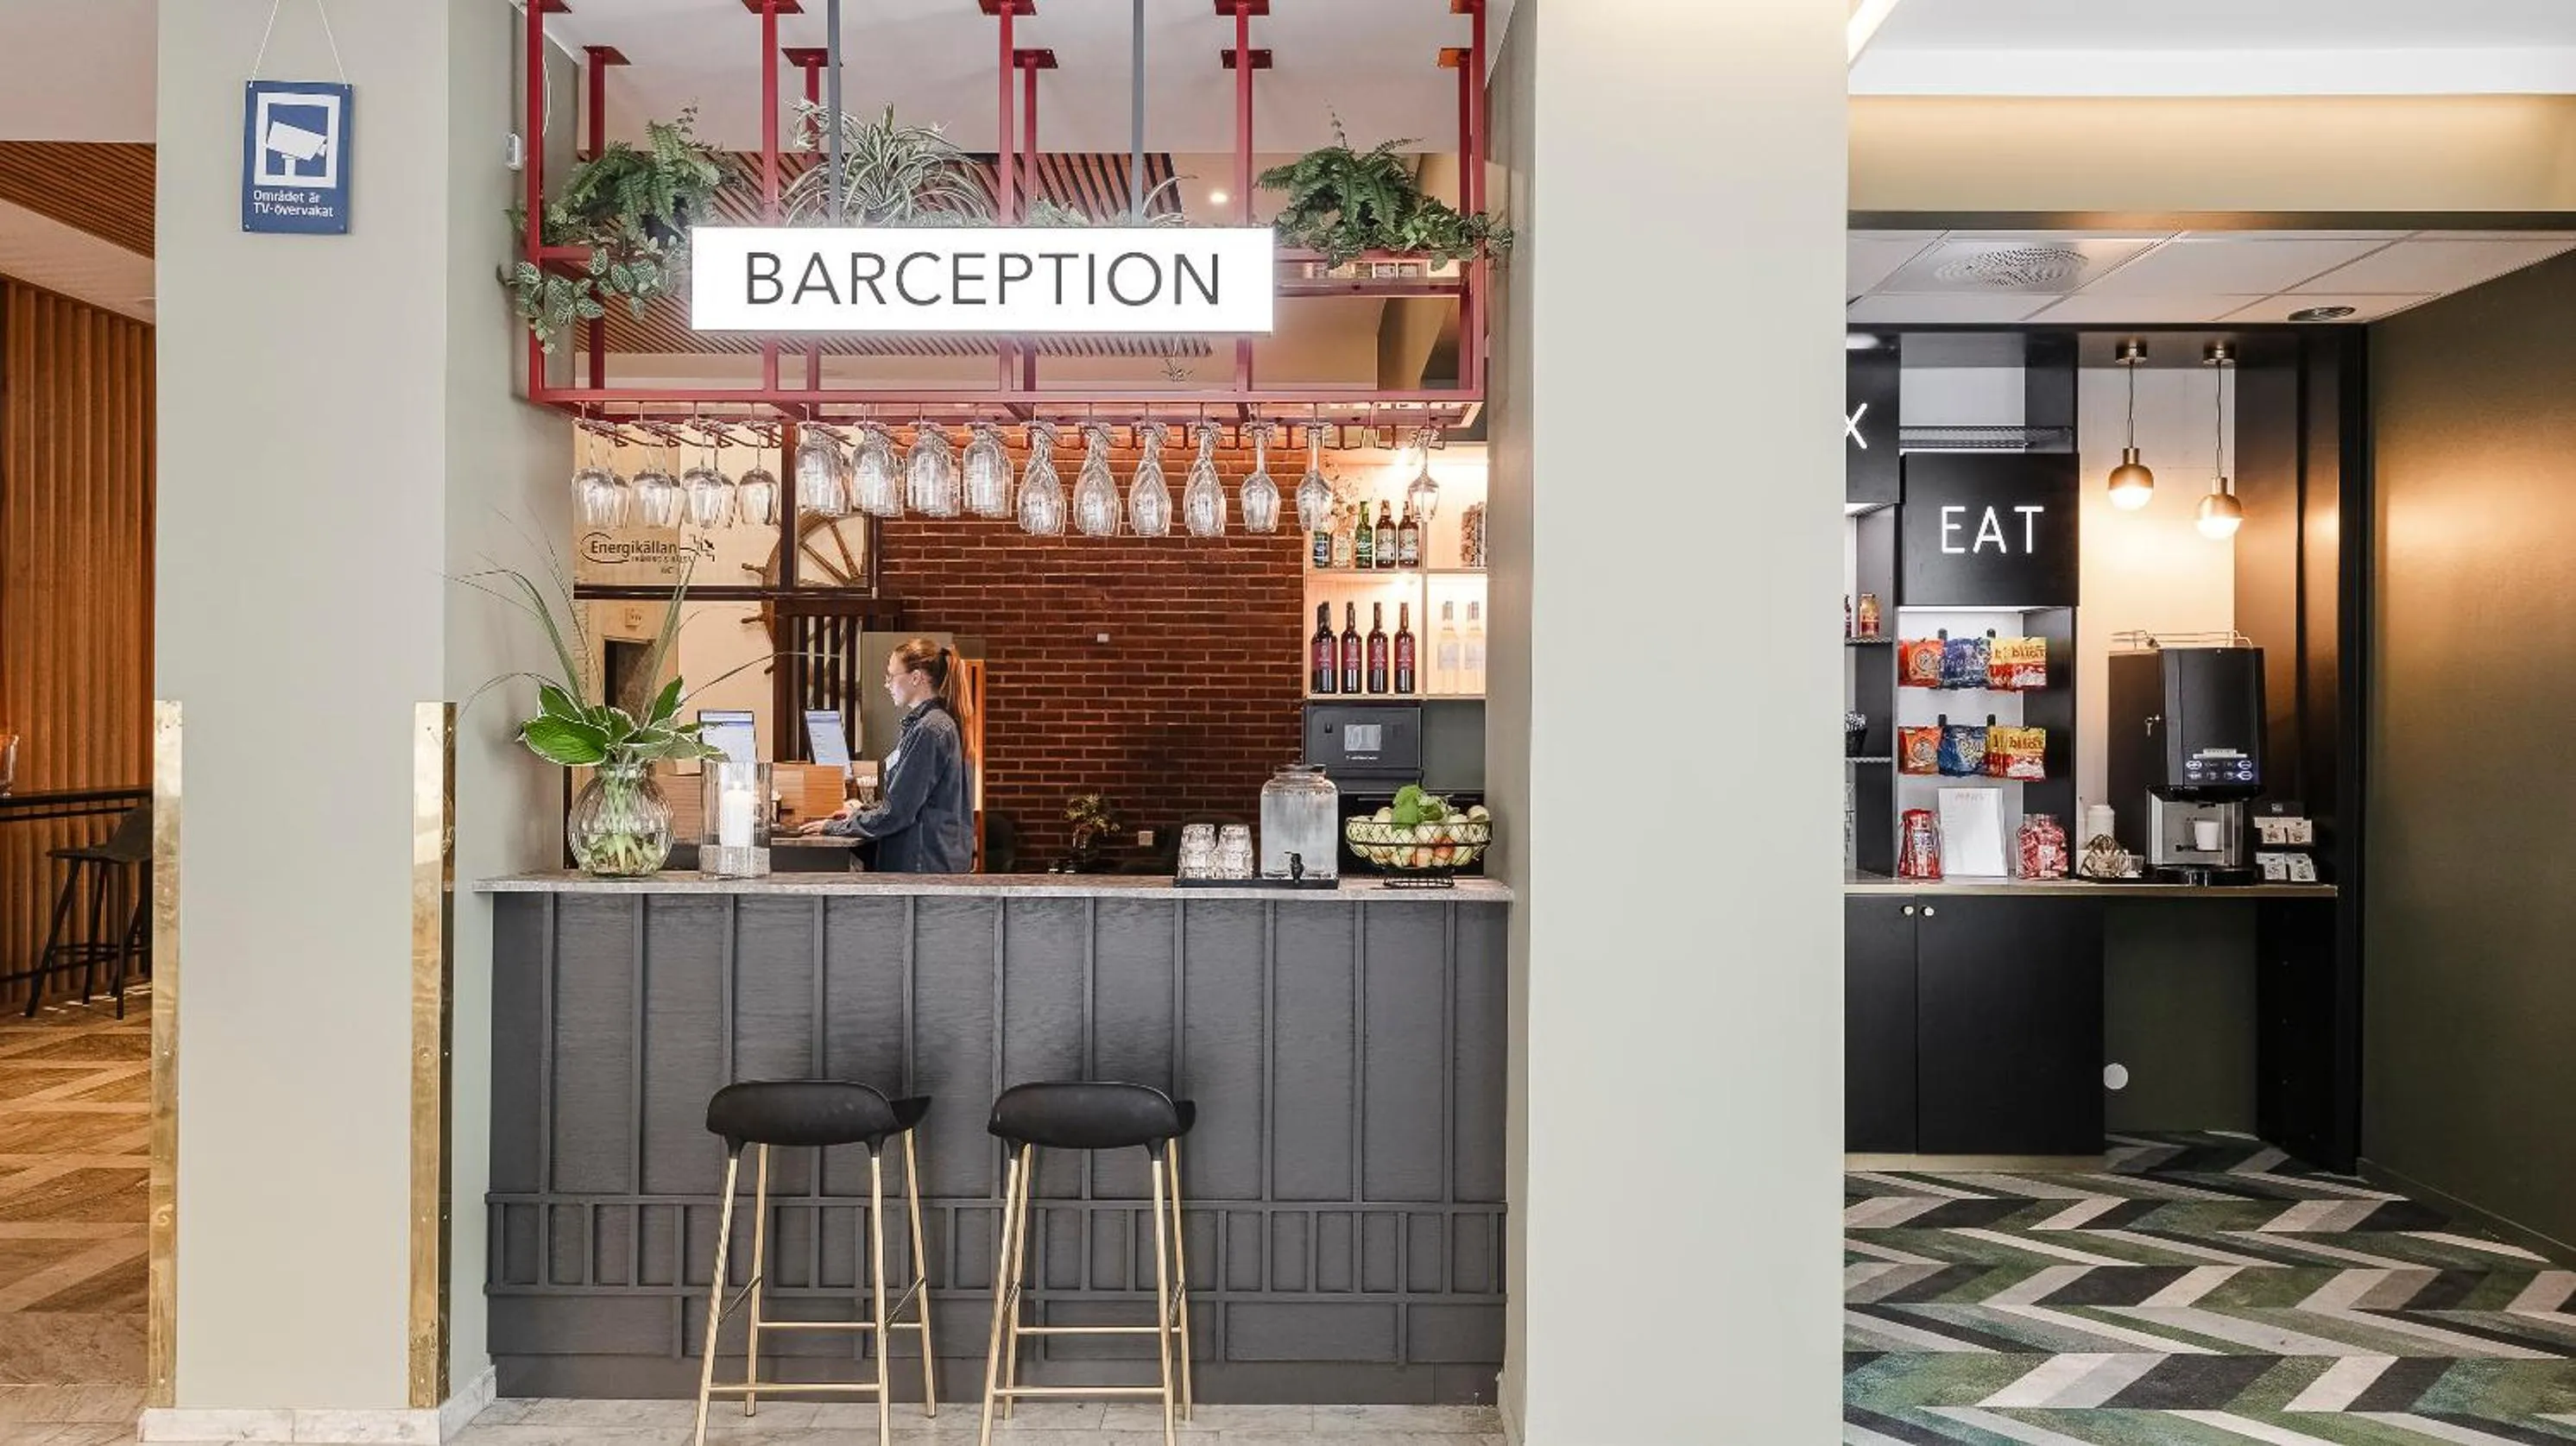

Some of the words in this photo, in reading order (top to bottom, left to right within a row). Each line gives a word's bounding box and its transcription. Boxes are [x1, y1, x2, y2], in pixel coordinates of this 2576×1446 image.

[254, 190, 304, 203] Området
[309, 193, 319, 203] är
[254, 202, 333, 218] TV-övervakat
[746, 251, 1219, 306] BARCEPTION
[1941, 506, 2044, 553] EAT
[590, 540, 678, 559] Energikällan
